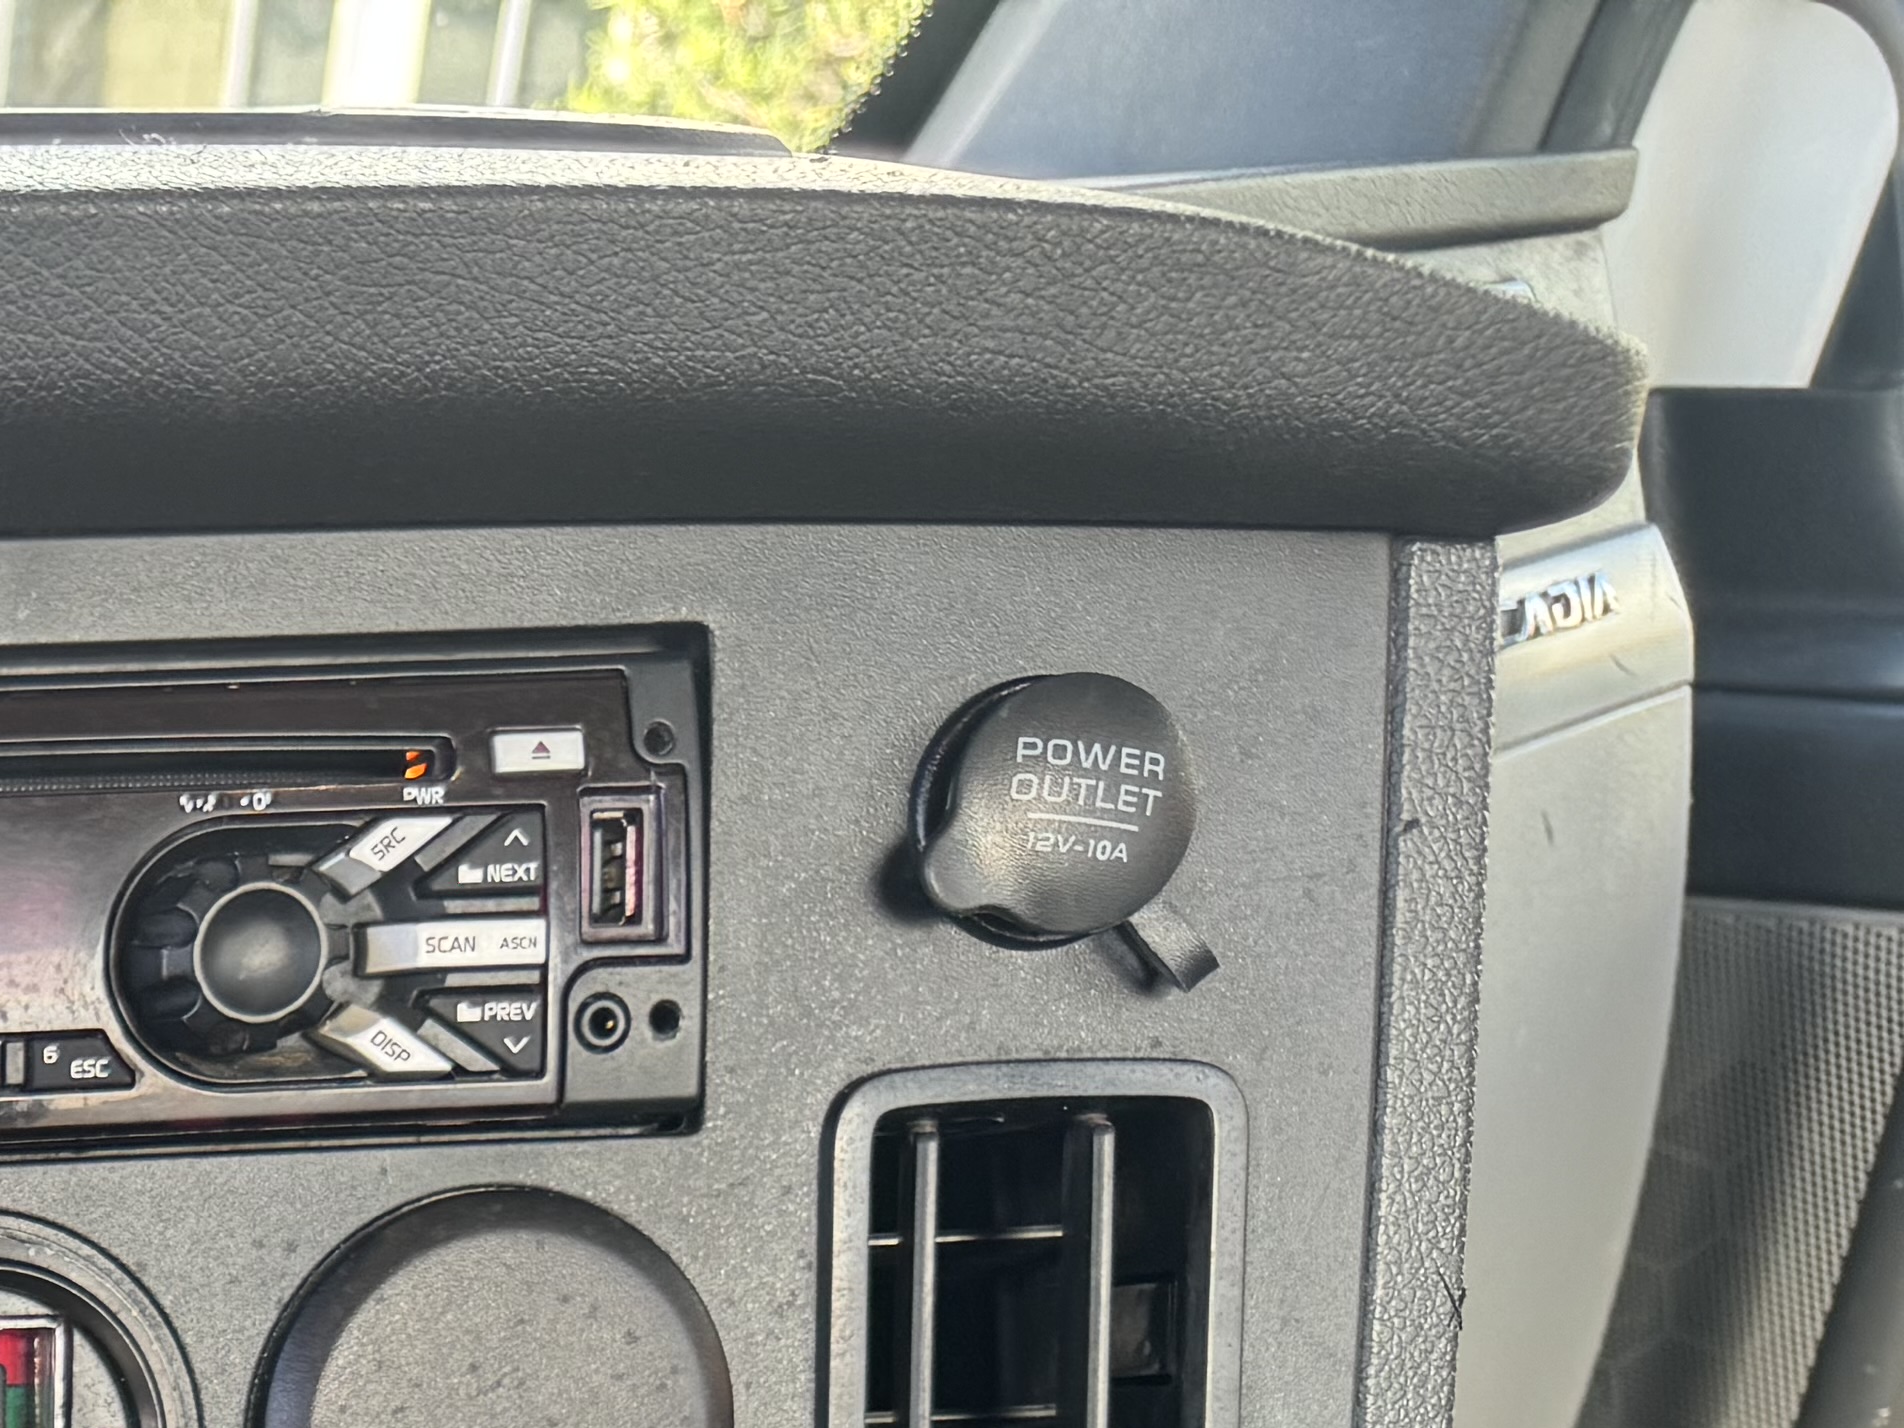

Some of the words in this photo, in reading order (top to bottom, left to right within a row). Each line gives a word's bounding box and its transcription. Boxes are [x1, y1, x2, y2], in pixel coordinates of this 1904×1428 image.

[1016, 737, 1165, 780] POWER
[403, 786, 443, 805] PWR
[1010, 773, 1163, 816] OUTLET
[370, 826, 406, 861] SRC
[1025, 831, 1128, 863] 12V-10A
[487, 862, 538, 882] NEXT
[425, 936, 476, 953] SCAN
[499, 936, 537, 950] ASCN
[484, 1001, 536, 1020] PREV
[43, 1045, 58, 1065] 6
[370, 1029, 411, 1063] DISP
[70, 1059, 111, 1079] ESC
